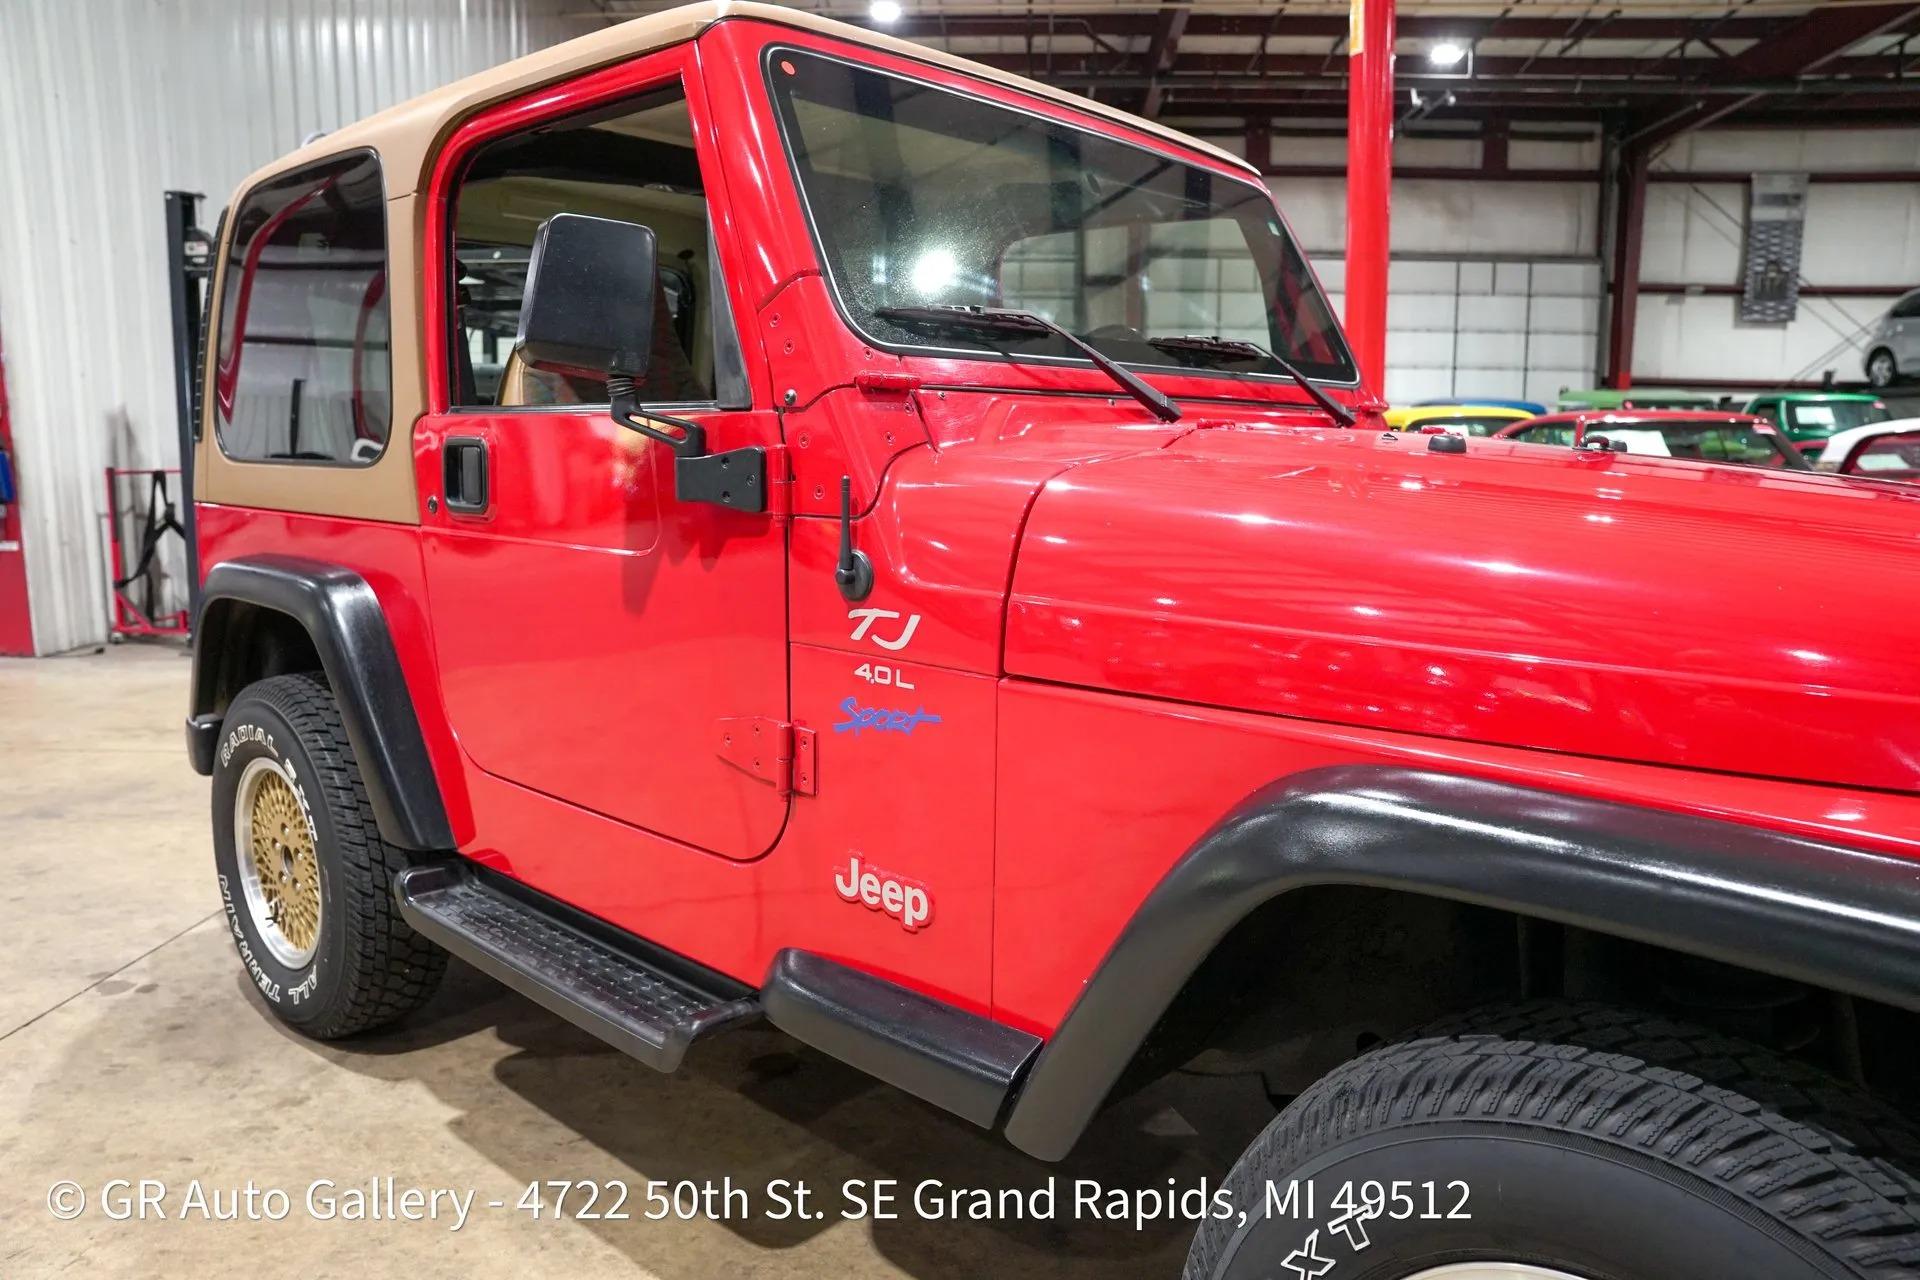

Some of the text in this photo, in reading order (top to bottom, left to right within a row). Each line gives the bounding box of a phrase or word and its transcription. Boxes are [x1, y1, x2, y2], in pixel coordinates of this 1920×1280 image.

[848, 608, 921, 650] TJ
[220, 724, 279, 768] RADIAL
[835, 857, 929, 927] Jeep
[218, 873, 318, 1005] ALL TERRAIN
